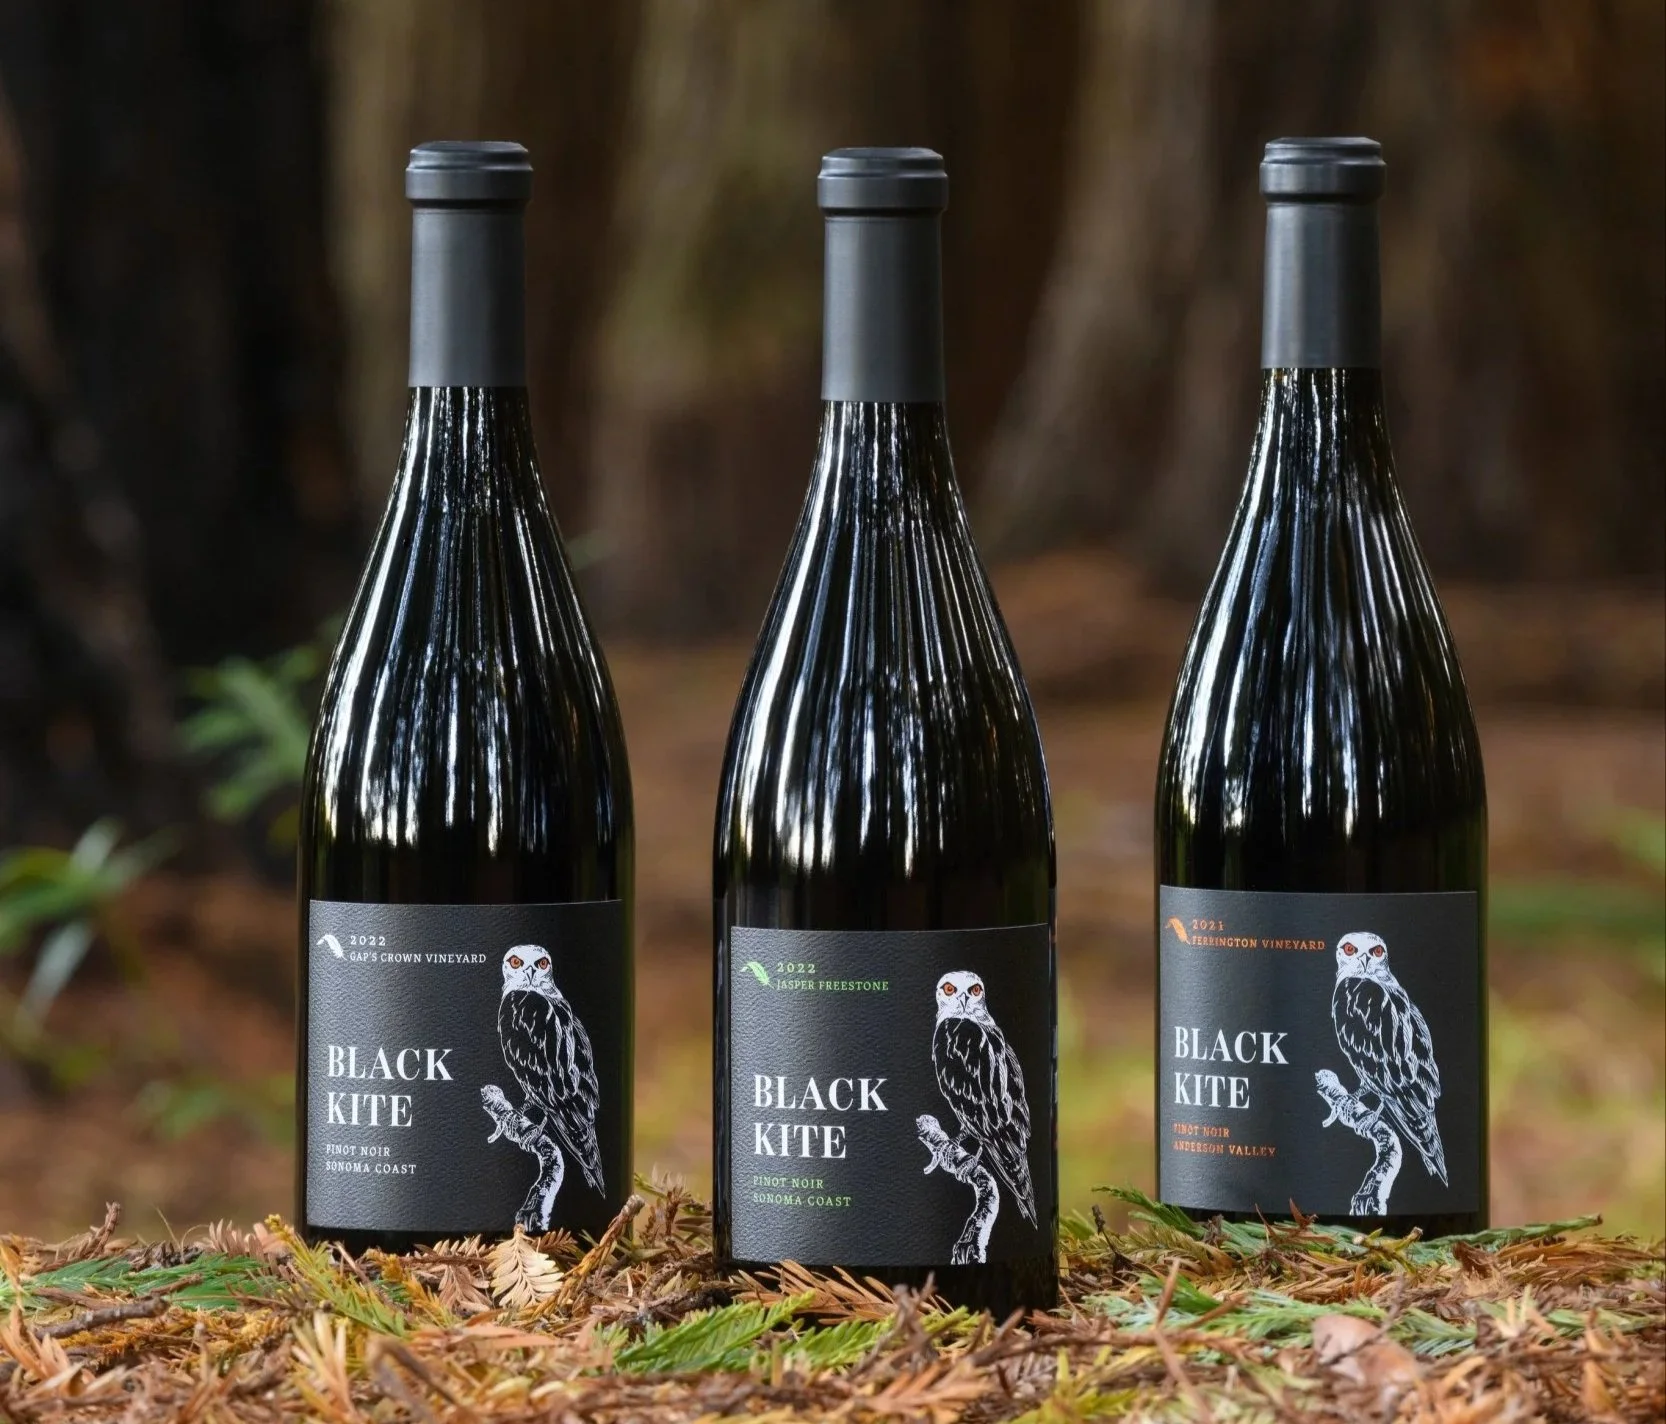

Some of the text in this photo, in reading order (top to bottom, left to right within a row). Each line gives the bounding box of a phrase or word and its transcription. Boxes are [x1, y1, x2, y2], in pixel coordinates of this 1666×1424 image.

[1192, 919, 1224, 930] 2021
[350, 935, 386, 946] 2022
[1262, 939, 1326, 950] VINEYARD
[350, 952, 487, 964] GAP'S CROWN VINEYARD
[777, 963, 816, 974] 2022
[776, 979, 889, 991] JASPER FREESTONE
[1174, 1026, 1289, 1064] BLACK
[328, 1045, 454, 1081] BLACK
[753, 1074, 888, 1111] BLACK
[1174, 1072, 1250, 1109] KITE
[327, 1092, 413, 1127] KITE
[1173, 1123, 1230, 1138] PINOT NOIR
[753, 1122, 846, 1159] KITE
[326, 1144, 391, 1157] PINOT NOIR
[1173, 1140, 1276, 1157] ANDERSON VALLEY
[326, 1160, 417, 1174] SONOMA COAST
[753, 1176, 824, 1189] PINOT NOIR
[753, 1192, 851, 1207] SONOMA COAST
